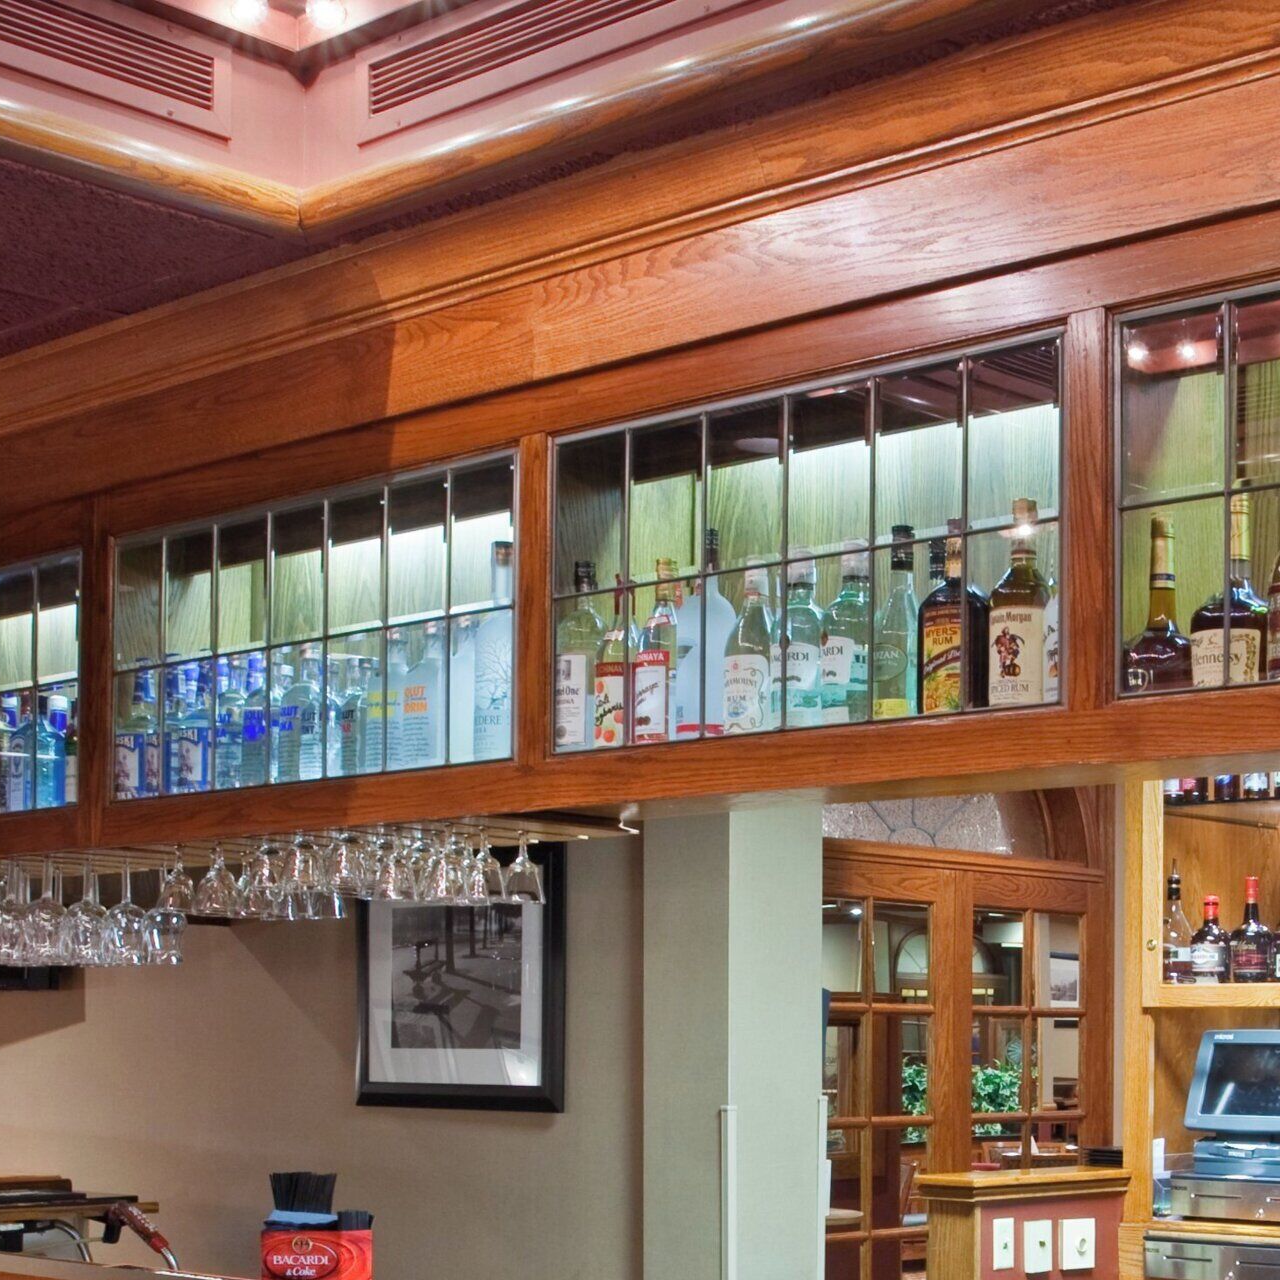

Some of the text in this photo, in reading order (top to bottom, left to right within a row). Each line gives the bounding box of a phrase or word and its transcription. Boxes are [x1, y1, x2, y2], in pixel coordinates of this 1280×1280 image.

[1005, 611, 1033, 624] Morgan
[932, 636, 953, 646] RUM
[822, 645, 844, 656] ARDI
[1192, 653, 1242, 668] Hennesy
[273, 1255, 329, 1265] BACARDI
